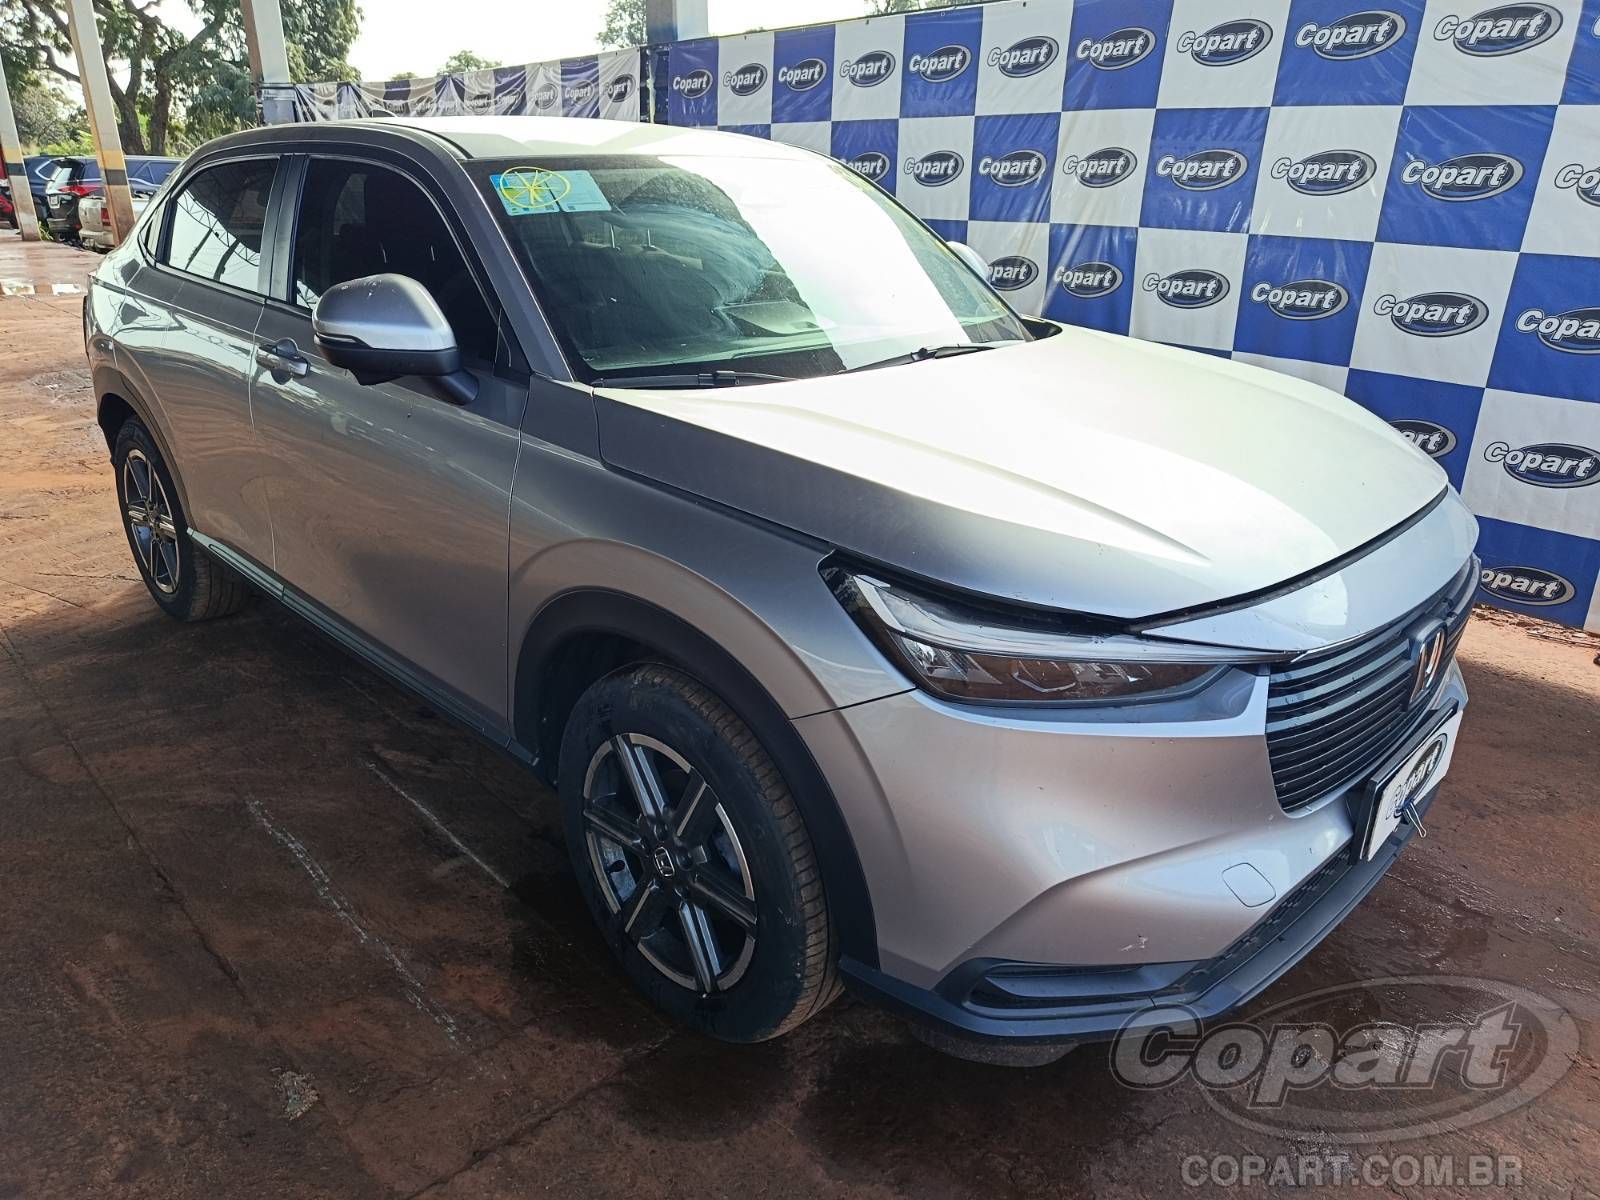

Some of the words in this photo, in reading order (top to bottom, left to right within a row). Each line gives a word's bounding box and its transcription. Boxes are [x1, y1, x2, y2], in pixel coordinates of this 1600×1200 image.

[1177, 26, 1261, 57] Copart
[1296, 15, 1396, 51] Copart
[1434, 9, 1547, 47] Copart
[987, 39, 1054, 74] Copart
[1077, 33, 1146, 61] Copart
[779, 60, 823, 89] Copart
[840, 53, 891, 83] Copart
[910, 48, 967, 79] Copart
[673, 72, 708, 97] Copart
[723, 66, 763, 94] Copart
[904, 154, 959, 184] Copart
[979, 154, 1042, 184] Copart
[1063, 154, 1129, 182] Copart
[1156, 154, 1236, 184] Copart
[1271, 156, 1364, 187] Copart
[1401, 159, 1507, 188] Copart
[1054, 265, 1115, 289] Copart
[1142, 272, 1219, 299] Copart
[1251, 282, 1339, 313] Copart
[1374, 294, 1472, 326] Copart
[1516, 308, 1600, 342] Copa
[1484, 441, 1596, 480] Copart
[1480, 569, 1559, 600] opart
